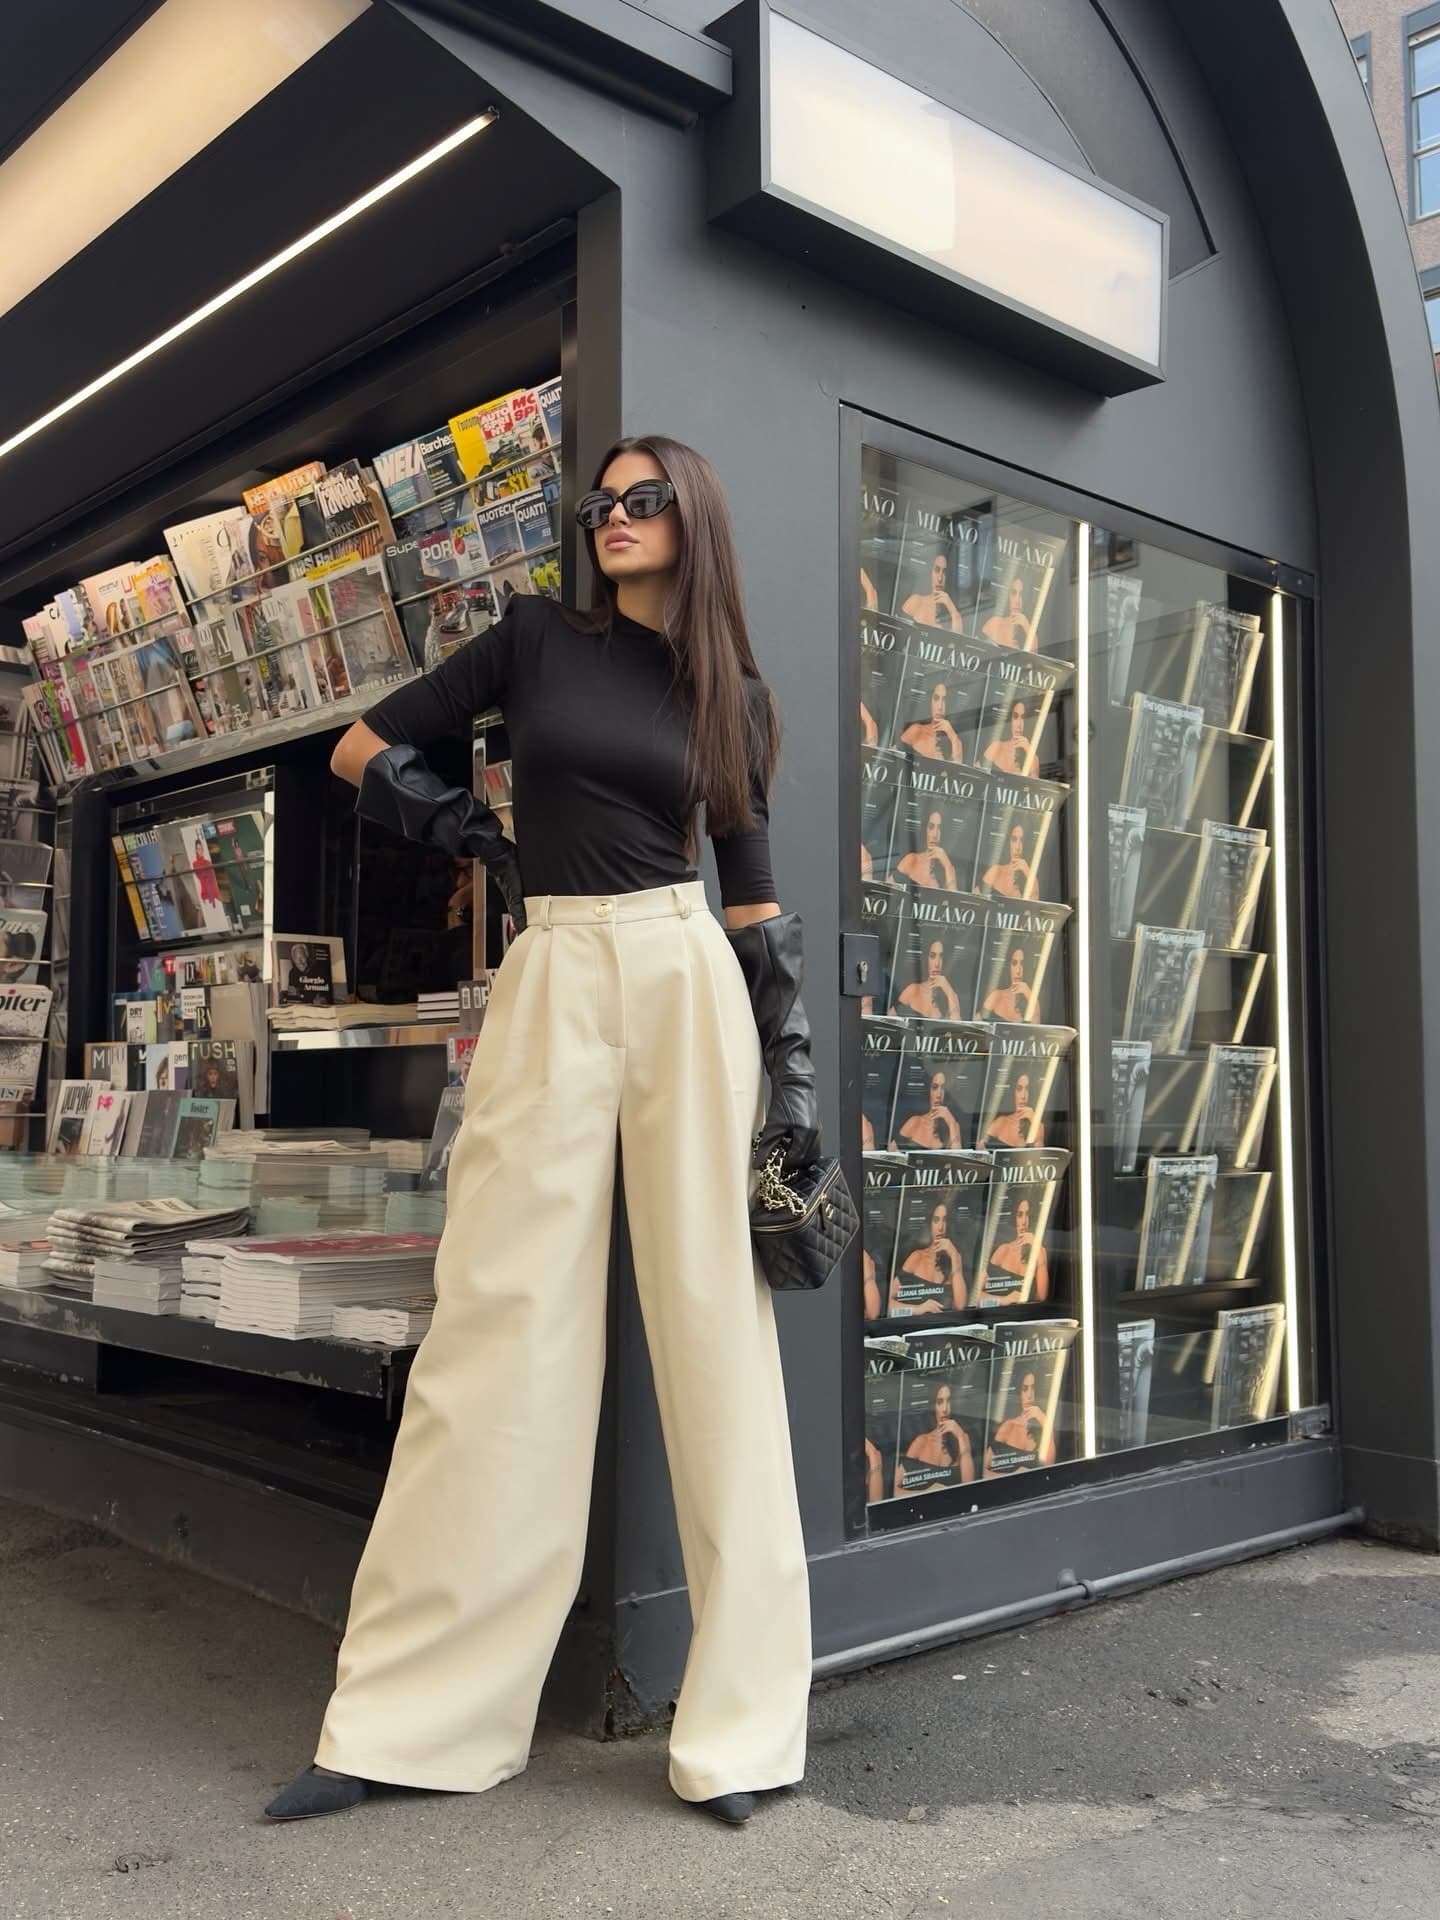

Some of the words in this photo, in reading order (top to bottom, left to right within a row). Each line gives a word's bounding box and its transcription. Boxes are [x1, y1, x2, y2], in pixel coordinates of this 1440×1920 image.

[915, 510, 979, 545] MILANO
[996, 535, 1054, 568] MILANO
[917, 641, 981, 672] MILANO
[999, 661, 1057, 690] MILANO
[911, 771, 974, 798] MILANO
[995, 786, 1054, 811] MILANO
[911, 902, 976, 926] MILANO
[995, 912, 1055, 933] MILANO
[190, 1042, 236, 1060] TUSH
[913, 1035, 979, 1055] MILANO
[1000, 1039, 1060, 1057] MILANO
[61, 1083, 93, 1114] purple
[913, 1168, 979, 1186] MILANO
[1001, 1165, 1057, 1183] MILANO
[914, 1345, 981, 1370] MILANO
[1003, 1336, 1065, 1358] MILANO
